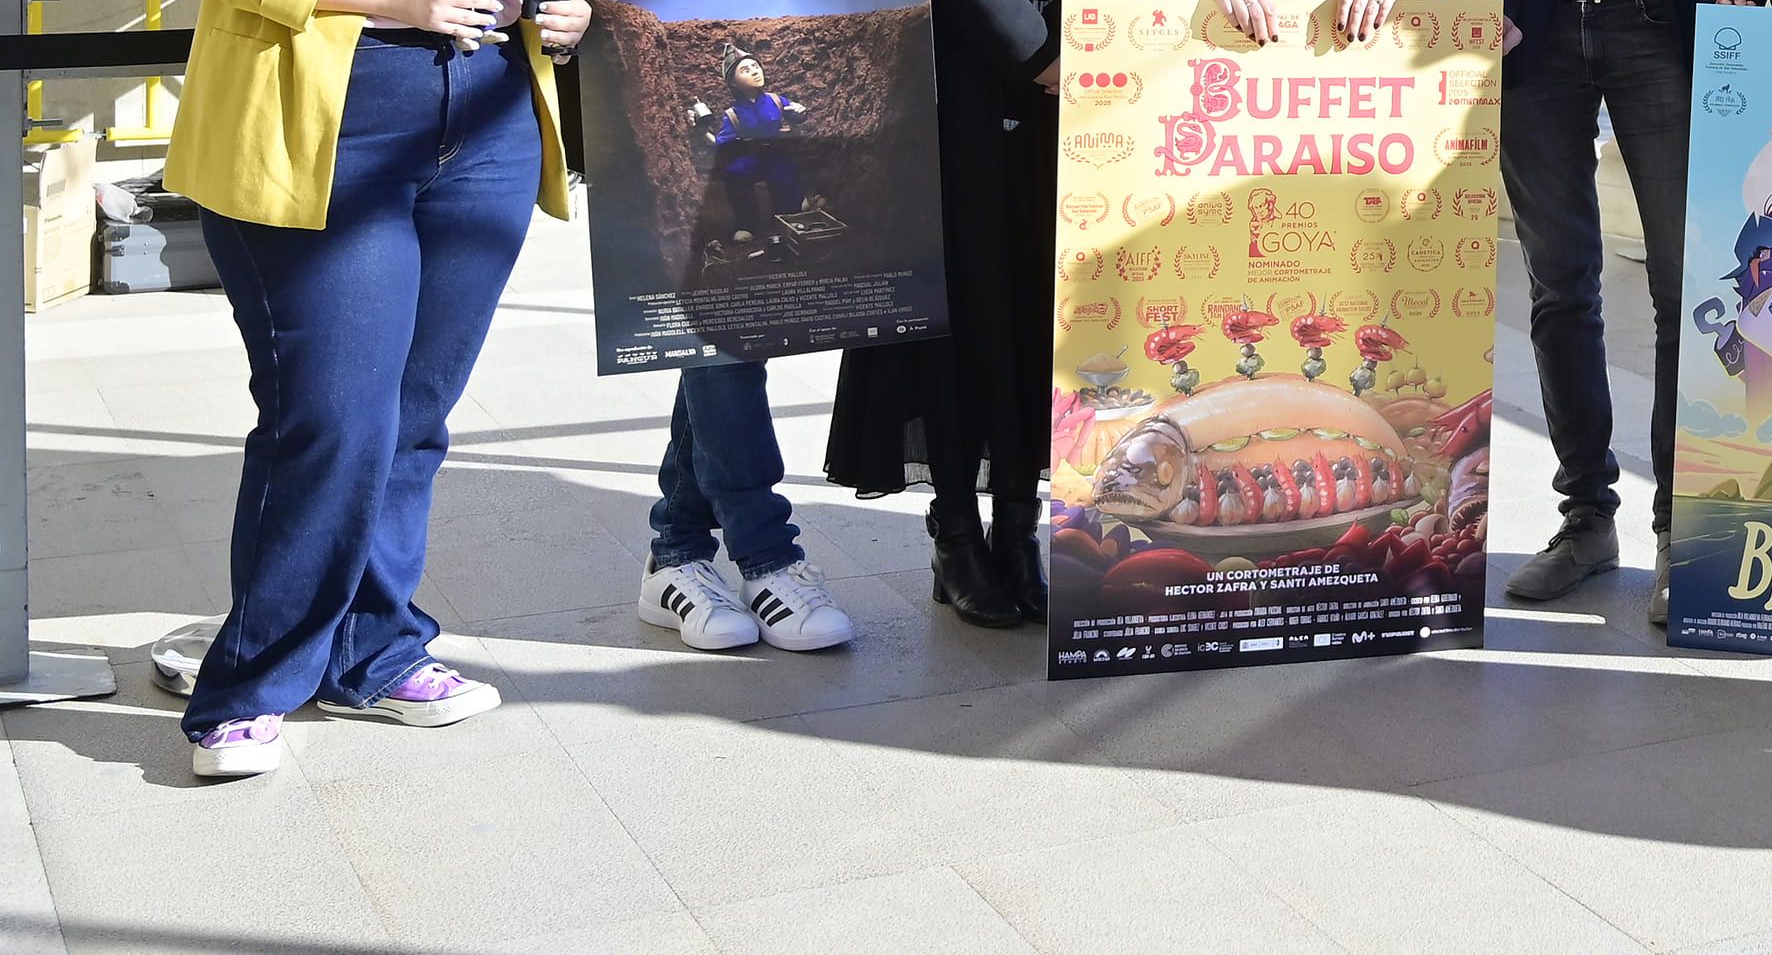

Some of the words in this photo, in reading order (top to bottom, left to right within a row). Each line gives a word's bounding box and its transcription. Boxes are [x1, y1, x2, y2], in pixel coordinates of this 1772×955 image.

[1713, 51, 1741, 60] SSIFF
[1449, 70, 1487, 78] OFFICIAL
[1449, 79, 1497, 87] SELECTION
[1187, 58, 1415, 122] BUFFET
[1154, 112, 1415, 176] PARAISO
[1285, 201, 1316, 219] 40
[1261, 230, 1337, 253] GOYA
[1248, 260, 1301, 269] NOMINADO
[1274, 267, 1332, 275] CORTOMETRAJE
[1259, 275, 1301, 283] ANIMACIÓN
[1146, 305, 1178, 313] SHORT
[1206, 571, 1224, 582] UN
[1227, 565, 1322, 580] CORTOMETRAJE
[1325, 564, 1340, 574] DE
[1165, 584, 1214, 596] HECTOR
[1217, 582, 1257, 594] ZAFRA
[1259, 580, 1268, 590] Y
[1270, 577, 1306, 589] SANTI
[1308, 573, 1379, 586] AMEZQUETA
